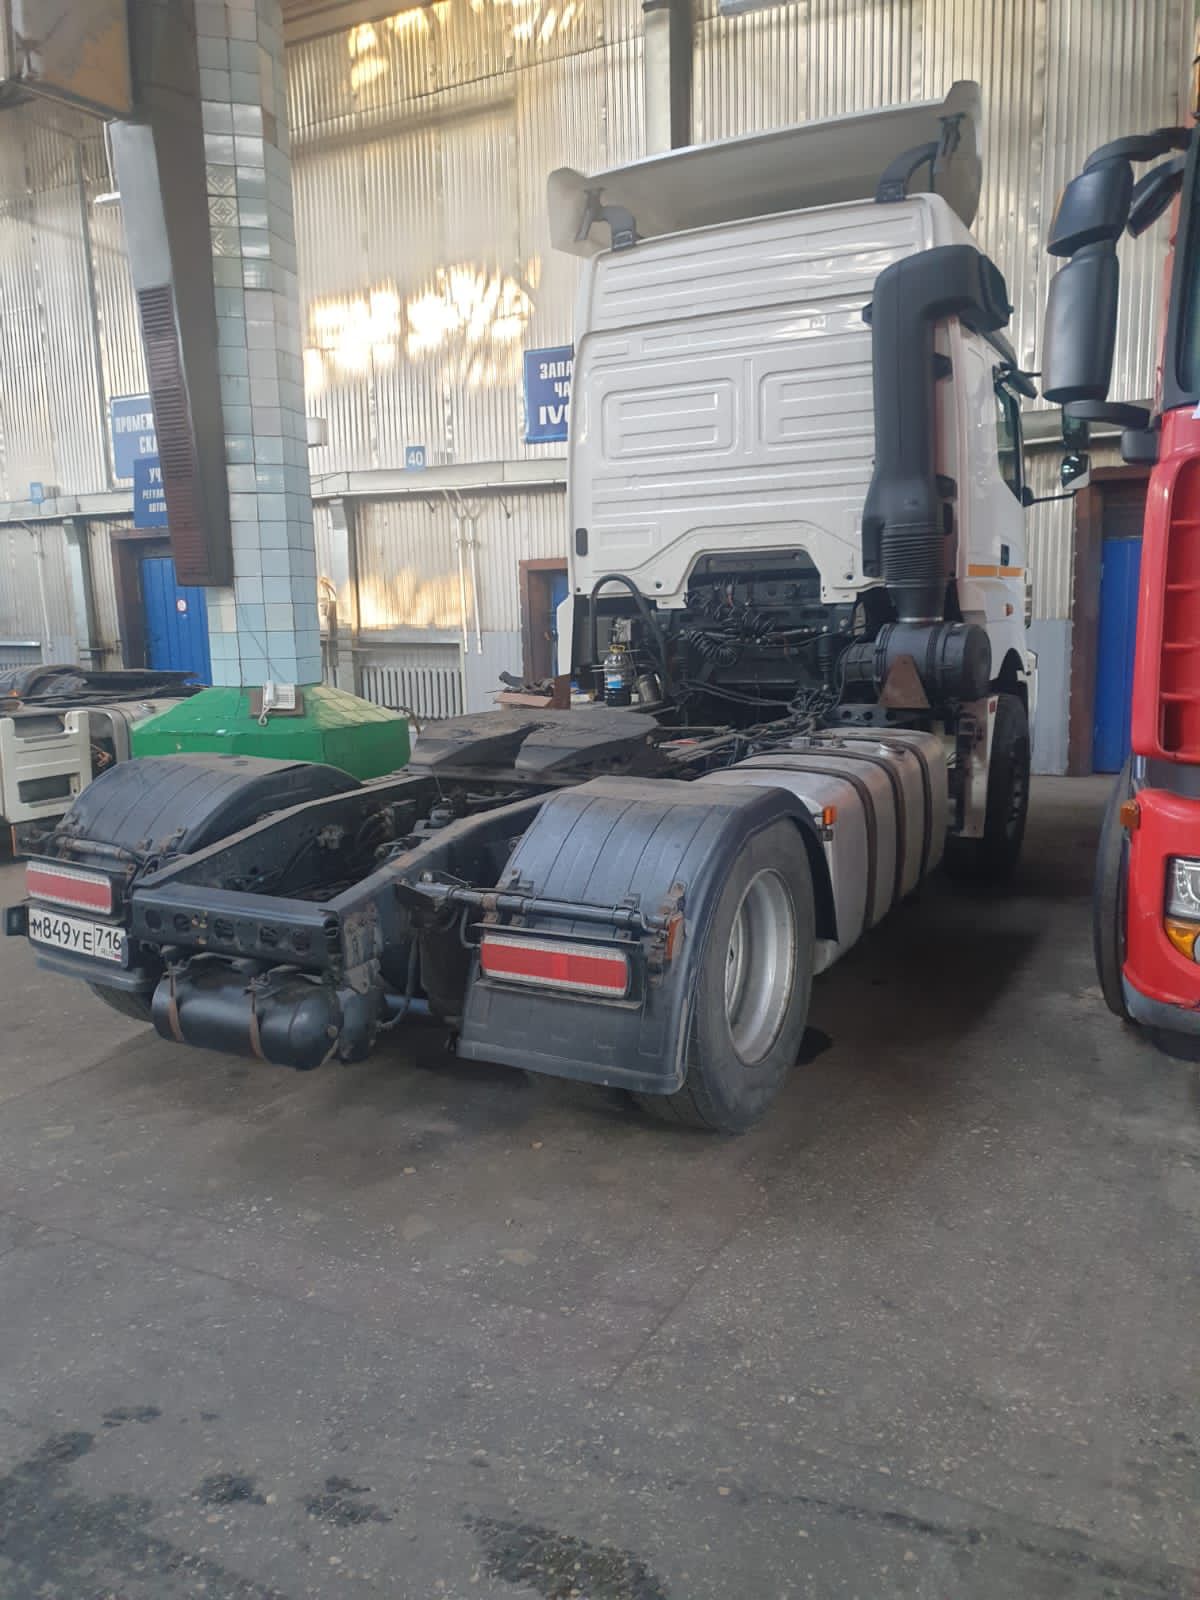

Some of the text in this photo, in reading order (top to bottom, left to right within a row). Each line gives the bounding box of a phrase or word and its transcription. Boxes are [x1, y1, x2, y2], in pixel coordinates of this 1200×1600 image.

[408, 451, 423, 466] 40
[149, 467, 164, 484] УЧ
[96, 928, 122, 951] 716
